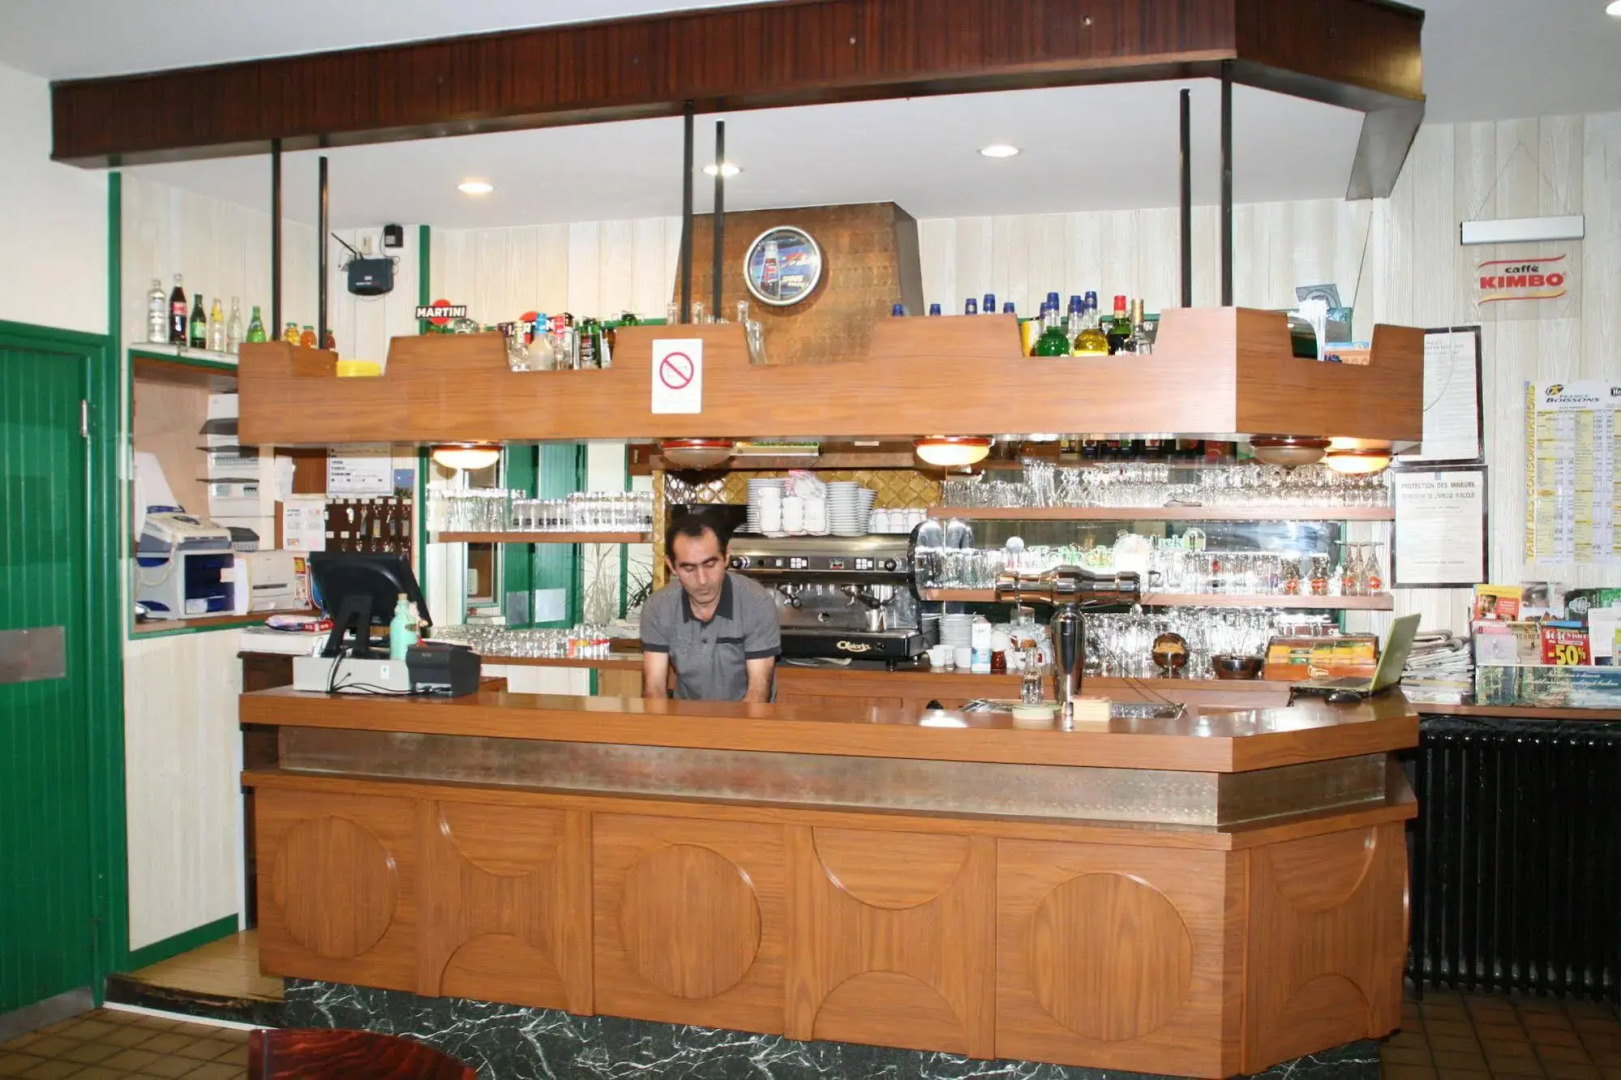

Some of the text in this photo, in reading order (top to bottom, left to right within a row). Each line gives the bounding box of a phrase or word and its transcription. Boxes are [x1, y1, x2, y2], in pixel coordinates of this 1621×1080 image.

[1480, 273, 1564, 289] KIMBO
[417, 307, 466, 317] MARTINI
[1526, 385, 1536, 558] TARIF DES CONSOMMATIONS
[1548, 644, 1586, 665] -50%
